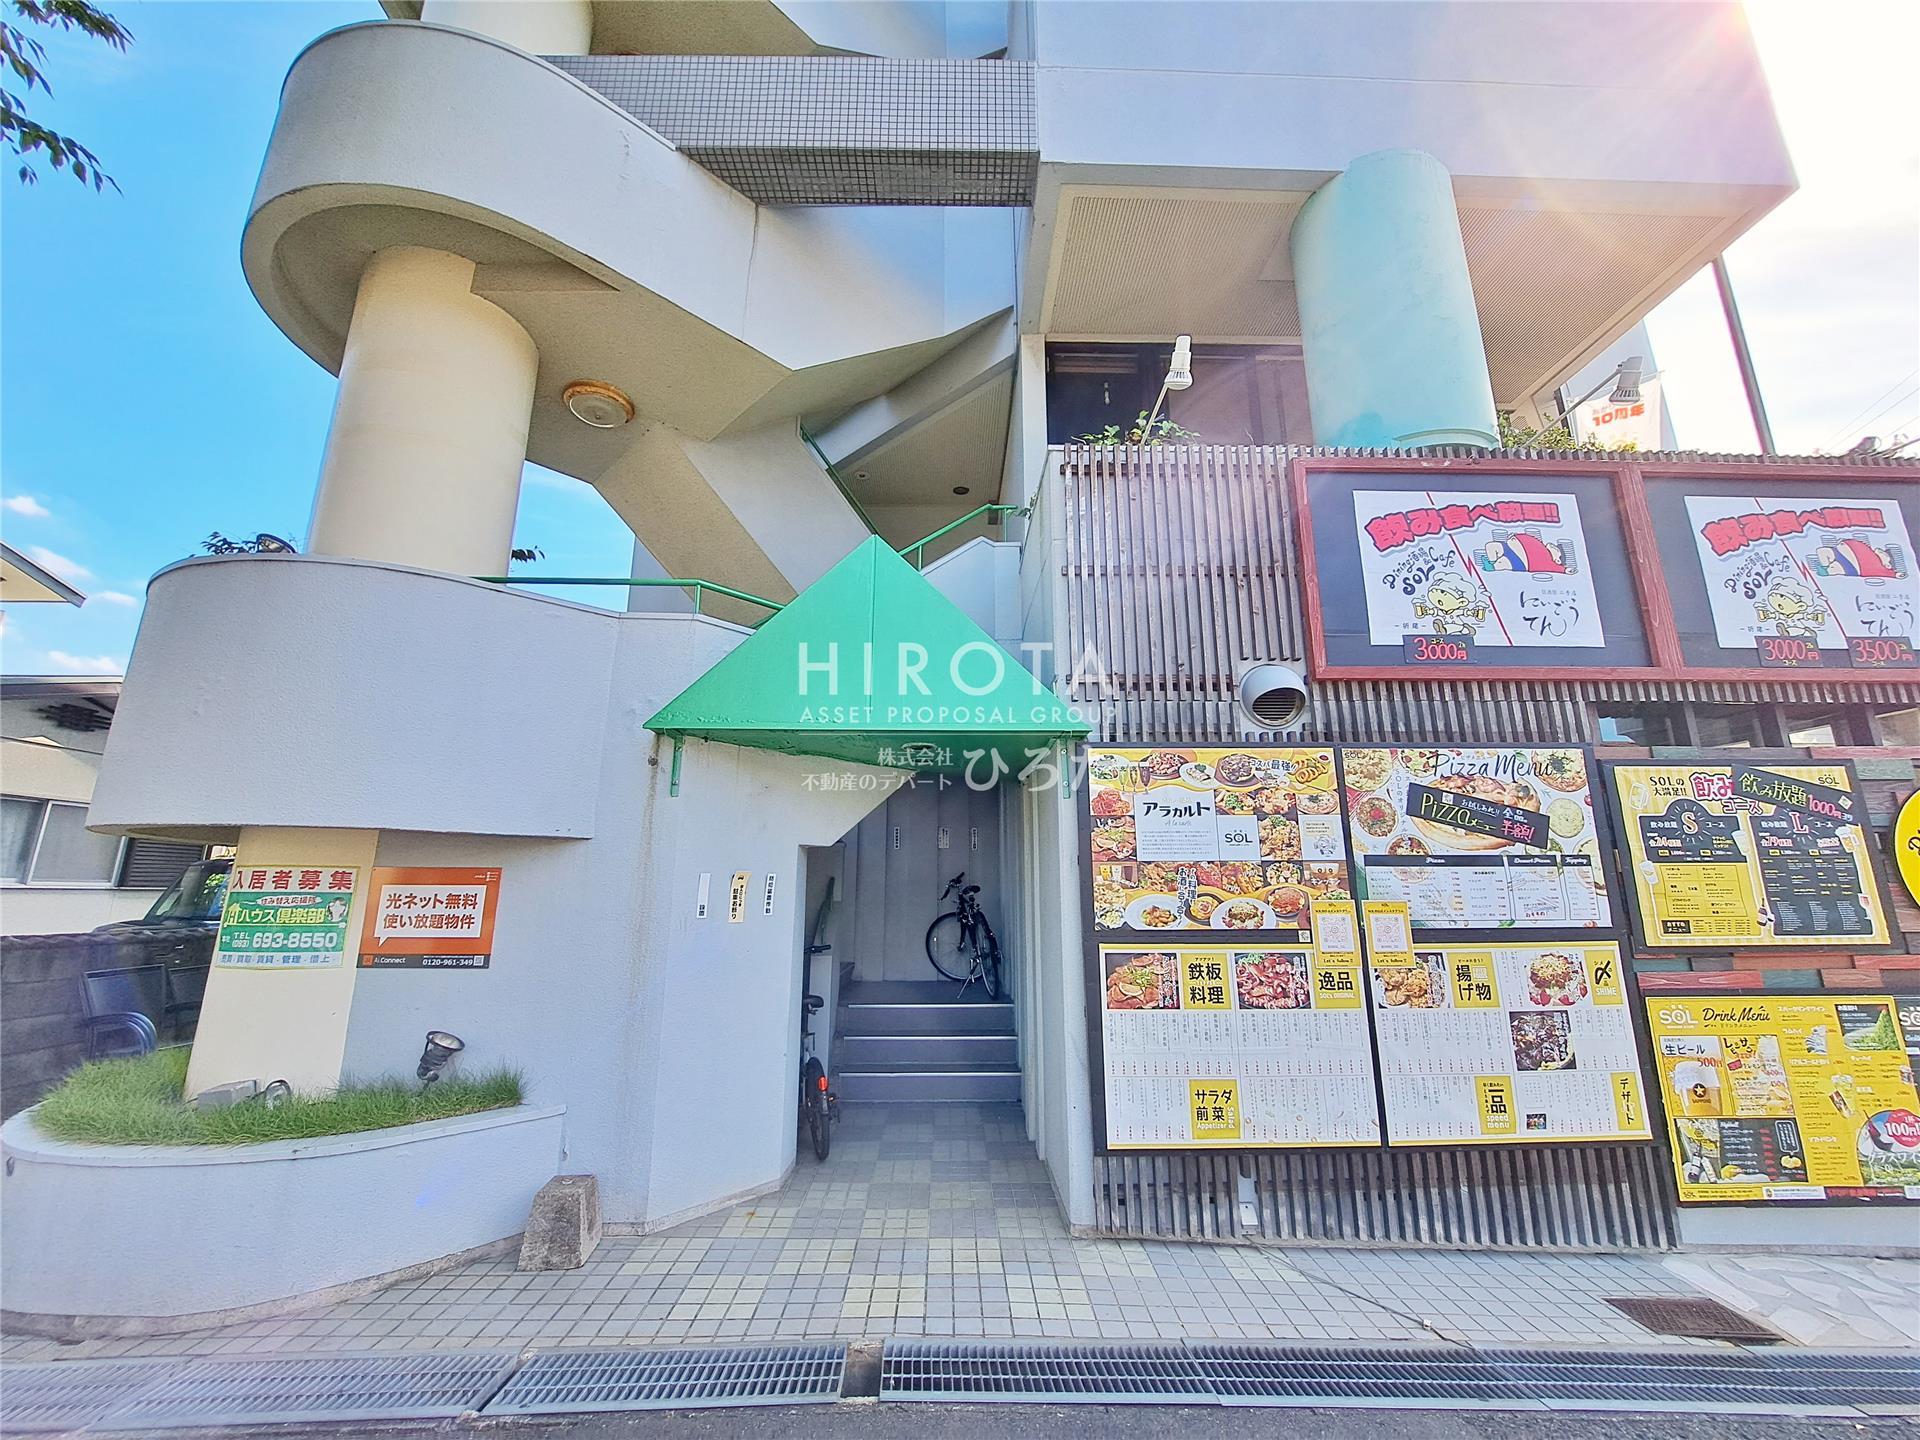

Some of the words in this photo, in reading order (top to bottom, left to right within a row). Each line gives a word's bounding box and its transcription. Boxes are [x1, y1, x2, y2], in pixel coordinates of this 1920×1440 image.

[1592, 403, 1645, 426] 10周年
[1426, 750, 1489, 777] Pizza
[1494, 754, 1553, 783] Menu
[1650, 776, 1684, 786] SOLの
[1738, 772, 1808, 806] 飲み放題
[1143, 801, 1211, 818] アラカルト
[1421, 792, 1471, 826] Pizza
[1721, 799, 1763, 815] コース
[1501, 819, 1535, 843] 半額!
[232, 869, 353, 890] 入居者募集
[385, 892, 478, 910] 光ネット無料
[239, 907, 326, 924] ハウス倶楽部
[383, 913, 476, 930] 使い放題物件
[233, 932, 251, 940] TEL
[252, 932, 338, 949] 693-8550
[1188, 962, 1223, 981] 鉄板
[1318, 970, 1354, 991] 逸品
[1189, 985, 1225, 1005] 料理
[1458, 982, 1492, 1001] げ物
[1702, 1007, 1737, 1022] Drink
[1737, 1006, 1770, 1023] Menu
[1665, 1044, 1706, 1056] 生ビール
[1194, 1089, 1233, 1104] サラダ
[1488, 1088, 1507, 1114] 一品
[1619, 1078, 1635, 1125] デザート
[1195, 1105, 1226, 1122] 前菜
[1196, 1122, 1227, 1130] Appetizer
